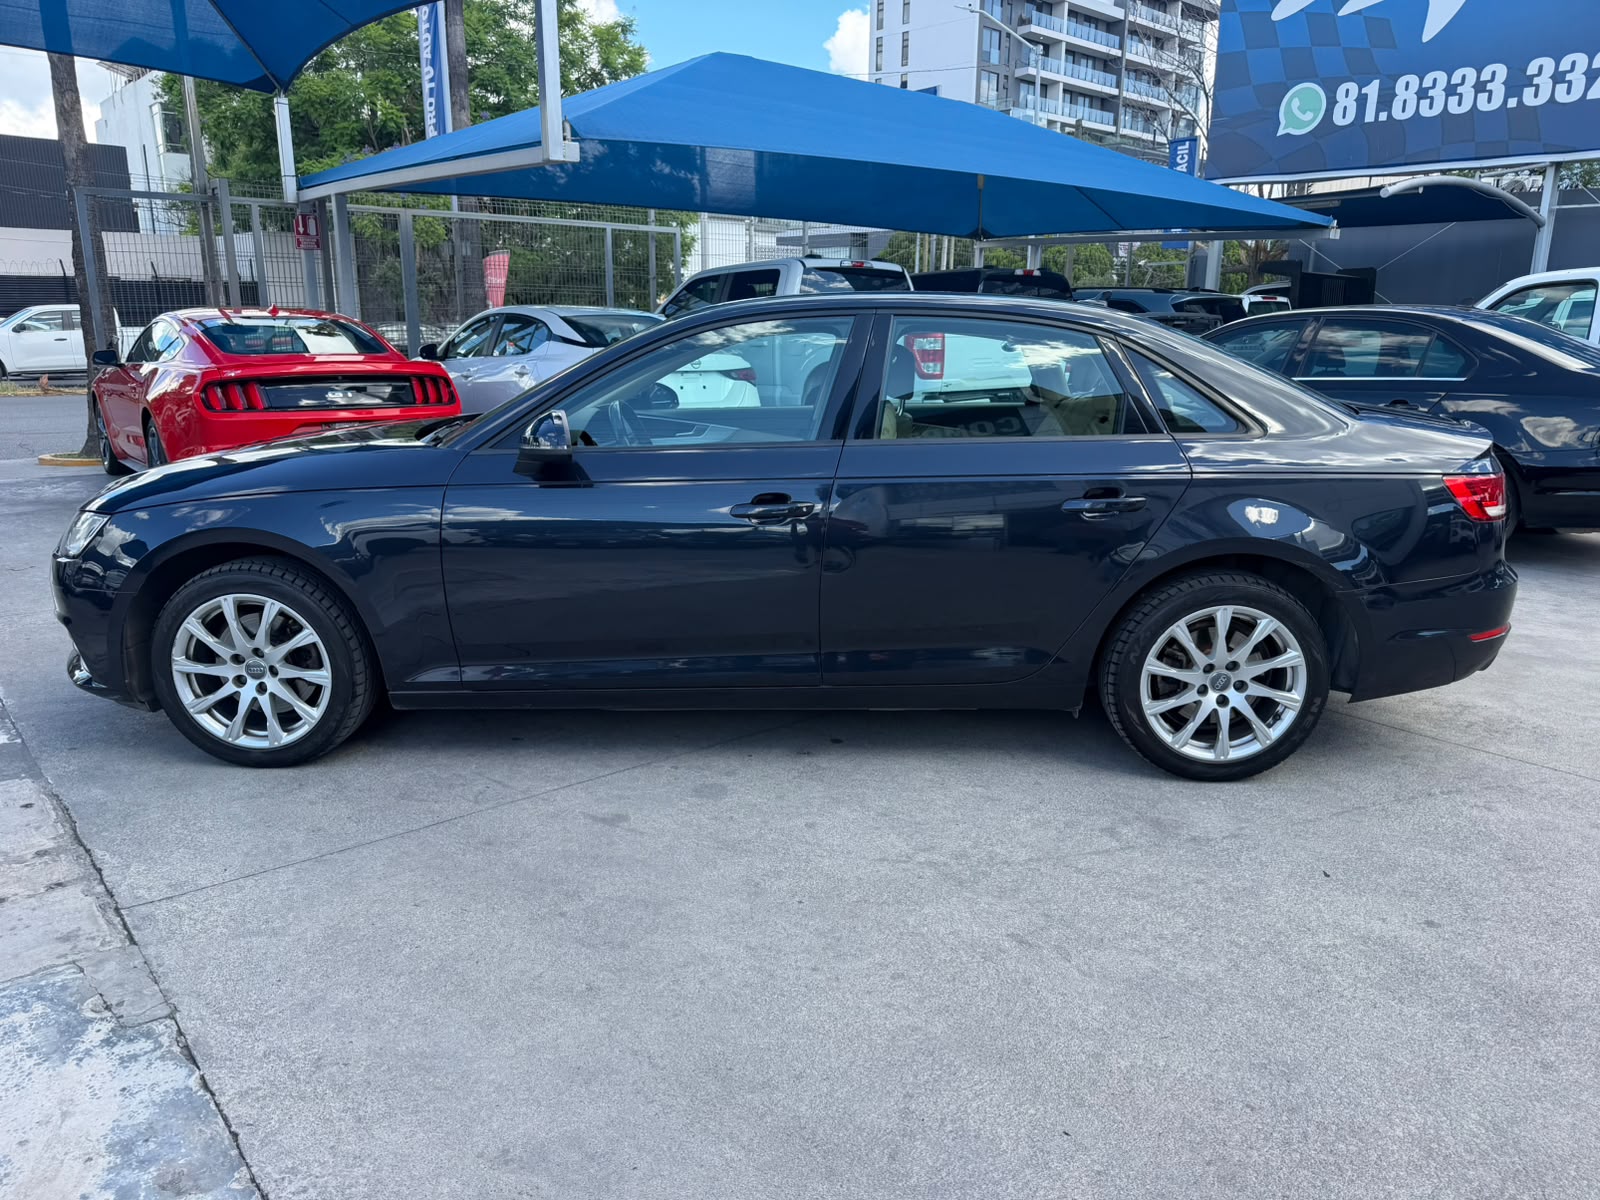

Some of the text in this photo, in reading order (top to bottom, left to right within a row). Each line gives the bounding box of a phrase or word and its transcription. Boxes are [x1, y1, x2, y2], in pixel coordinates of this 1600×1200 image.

[421, 6, 432, 59] AUTO
[424, 66, 436, 92] TU
[1173, 141, 1190, 172] ÁCIL
